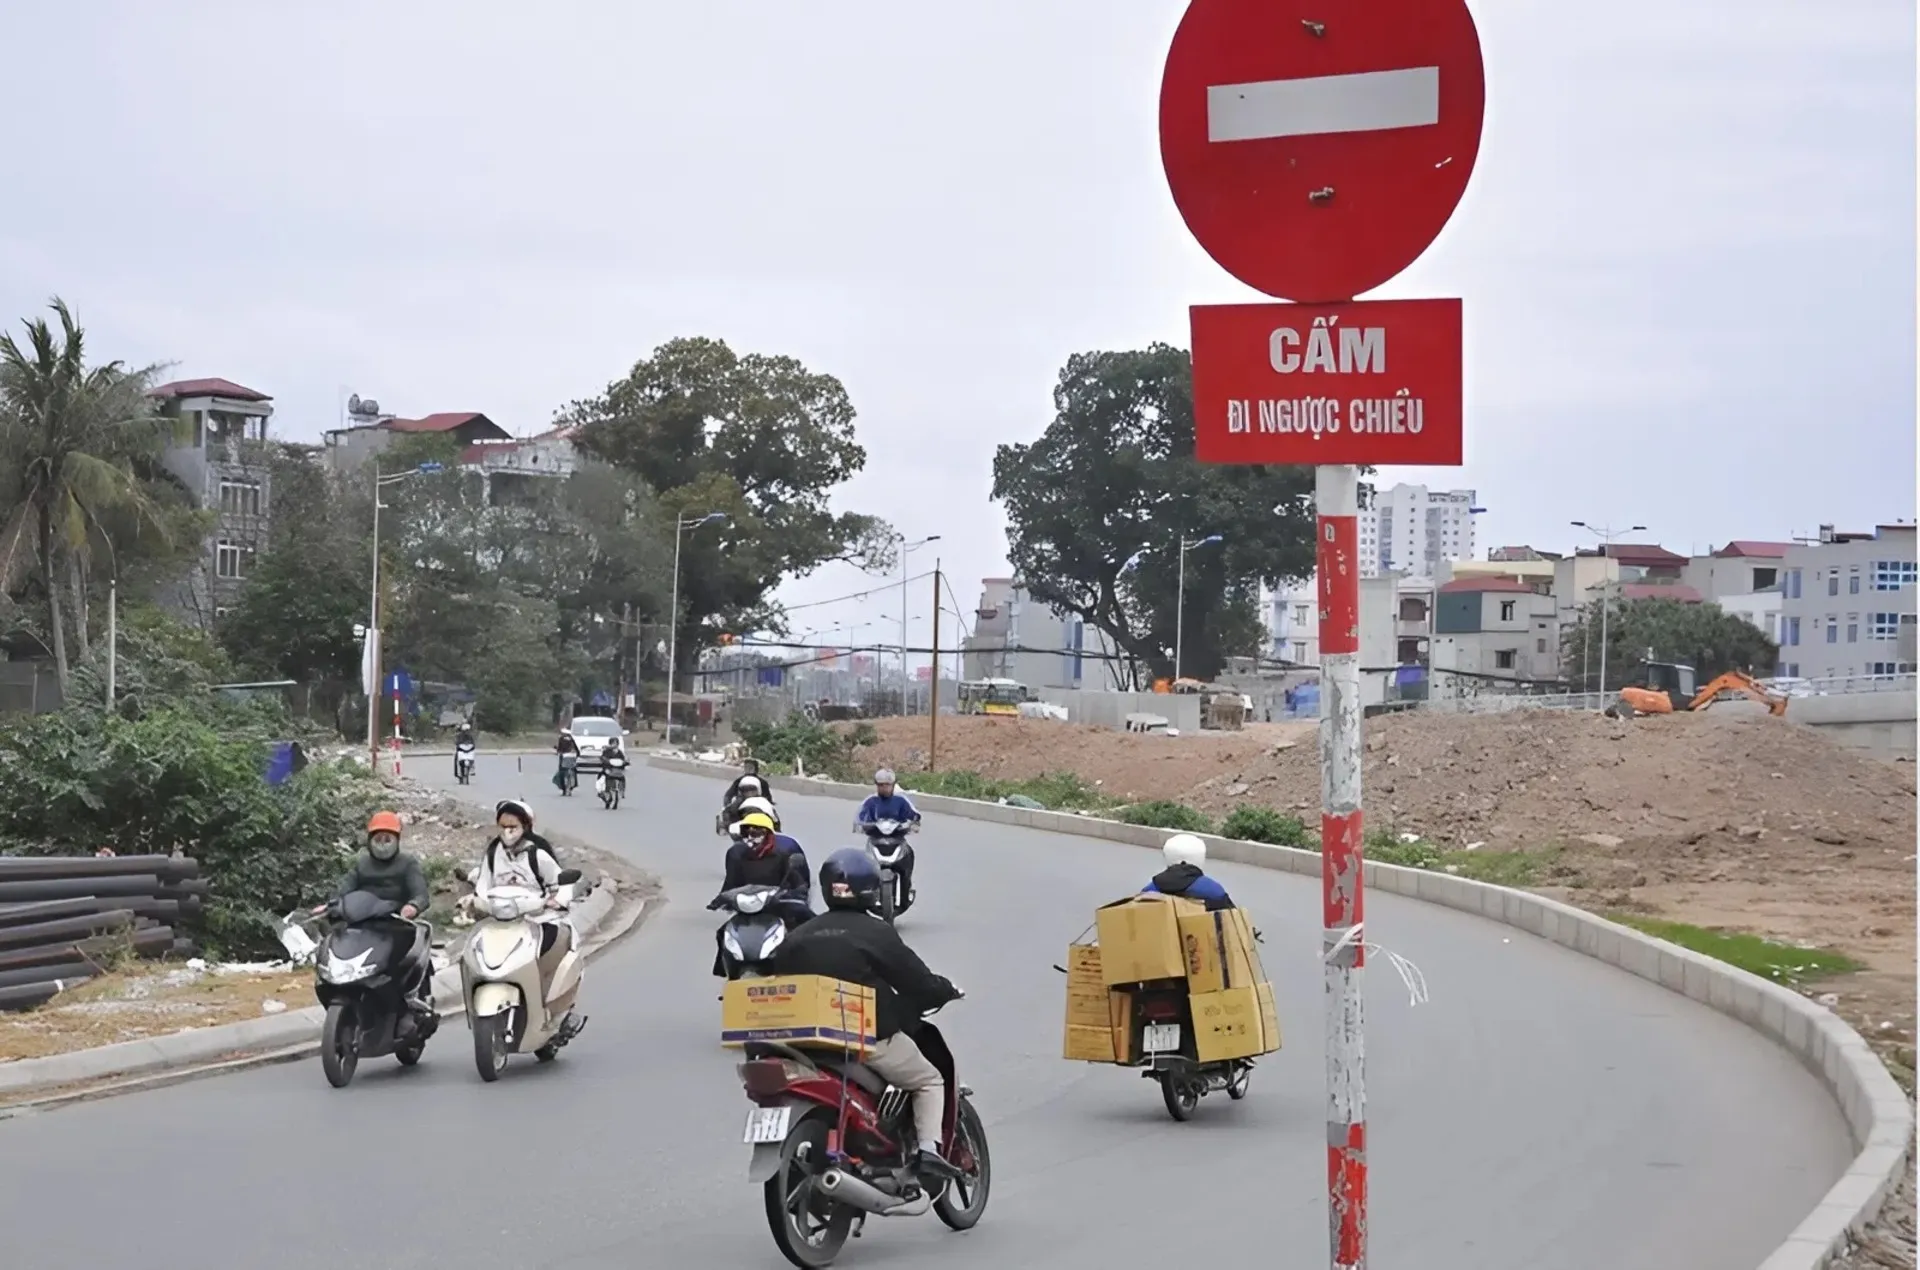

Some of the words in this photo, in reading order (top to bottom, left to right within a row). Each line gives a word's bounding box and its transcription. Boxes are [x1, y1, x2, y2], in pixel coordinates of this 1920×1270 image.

[1269, 315, 1385, 374] CẤM
[1227, 399, 1251, 433] ĐI
[1258, 396, 1340, 440] NGƯỢC
[1349, 388, 1423, 433] CHIỀU
